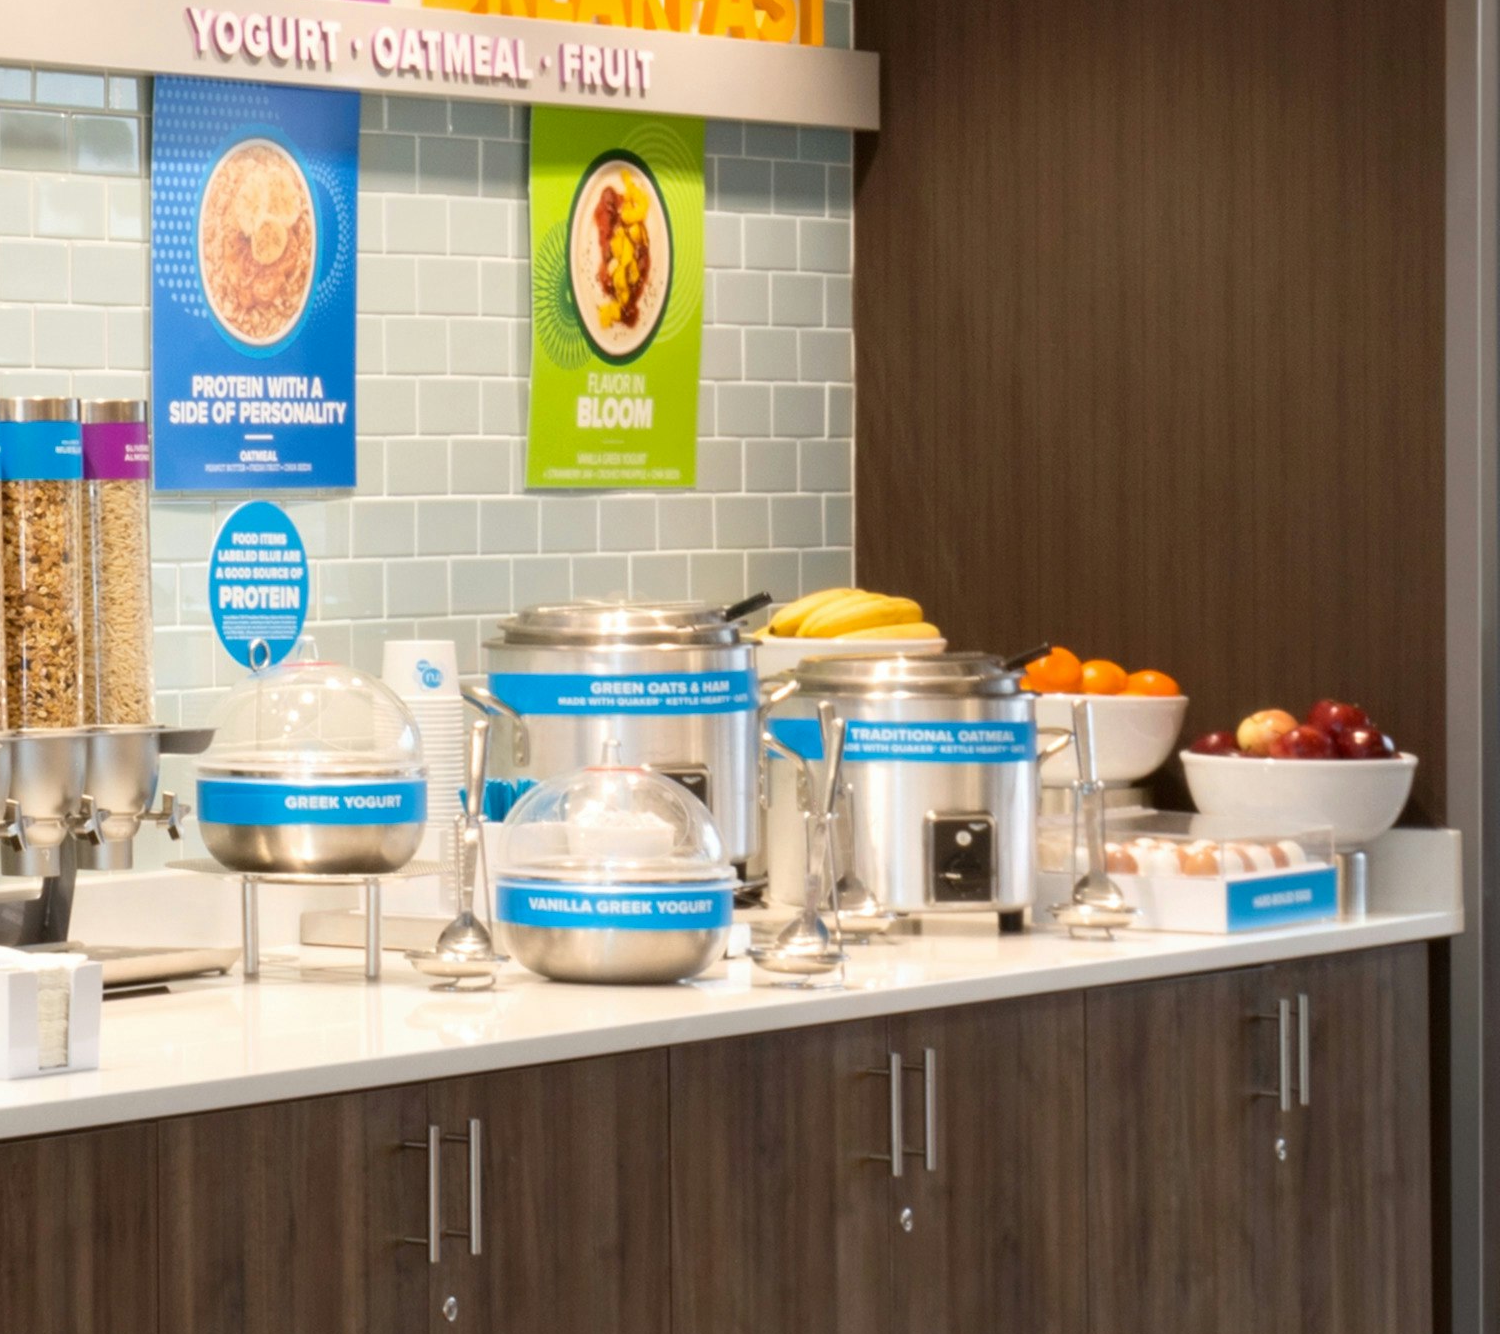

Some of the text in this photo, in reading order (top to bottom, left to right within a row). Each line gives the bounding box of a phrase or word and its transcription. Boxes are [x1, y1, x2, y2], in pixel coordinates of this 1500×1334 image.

[186, 6, 655, 91] YOGURT OATMEAL FRUIT
[192, 375, 323, 399] PROTEIN WITH A
[588, 372, 645, 394] FLAVOR IN
[169, 401, 347, 424] SIDE OF PERSONALITY
[576, 396, 654, 430] BLOOM
[239, 450, 278, 463] OATMEAL
[232, 532, 288, 546] FOOD ITEMS
[218, 549, 301, 563] LABELED BLUE ARE
[215, 567, 304, 580] A GOOD SOURCE OF
[218, 585, 301, 609] PROTEIN
[590, 680, 730, 695] GREEN OATS & HAM
[557, 696, 586, 706] MADE
[587, 696, 615, 706] WITH
[665, 696, 699, 706] KETTLE
[850, 727, 1015, 743] TRADITIONAL OATMEAL
[862, 743, 889, 753] WITH
[940, 744, 974, 754] KETTLE
[284, 794, 402, 810] GREEK YOGURT
[528, 896, 713, 915] VANILLA GREEK YOGURT
